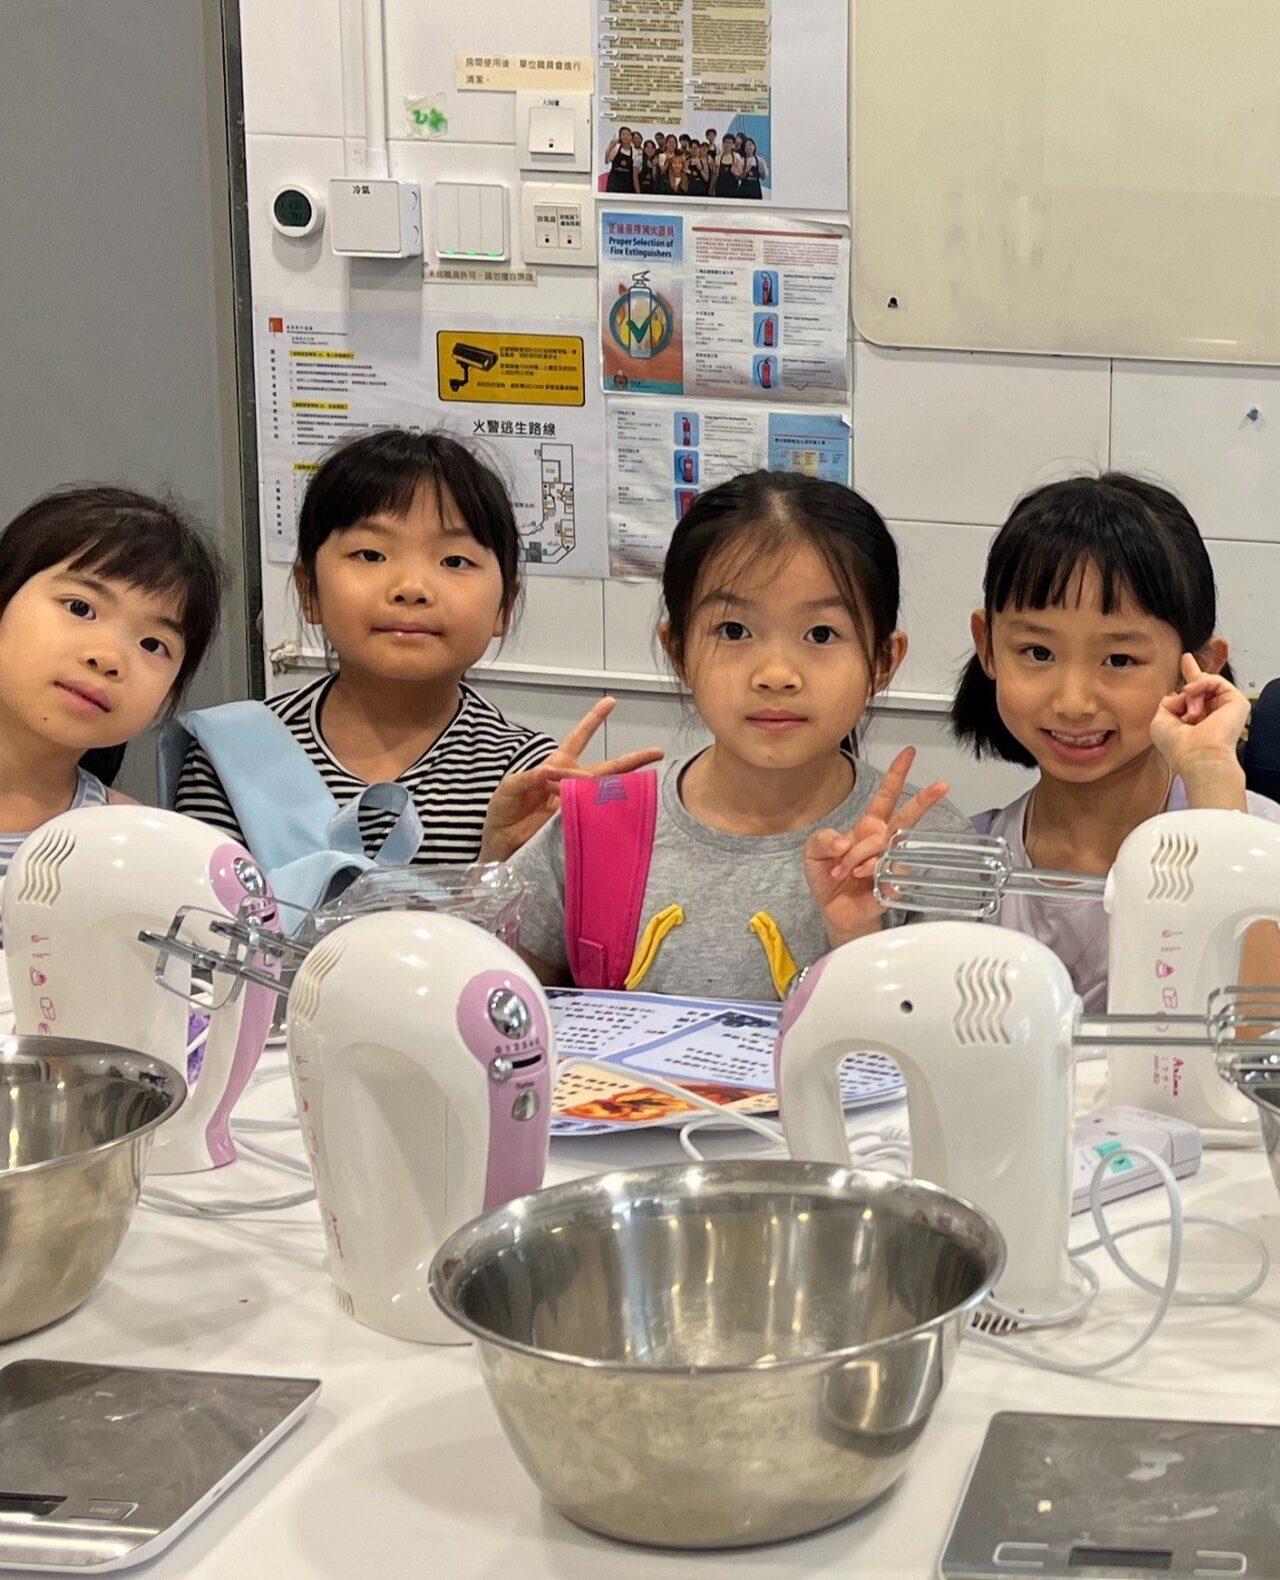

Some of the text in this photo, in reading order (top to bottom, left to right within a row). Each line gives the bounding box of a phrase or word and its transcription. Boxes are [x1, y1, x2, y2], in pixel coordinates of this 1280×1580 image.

[609, 237, 674, 248] Proper Selection of
[610, 246, 672, 259] Fire Extinguishers
[473, 419, 556, 436] 火警逃生路線
